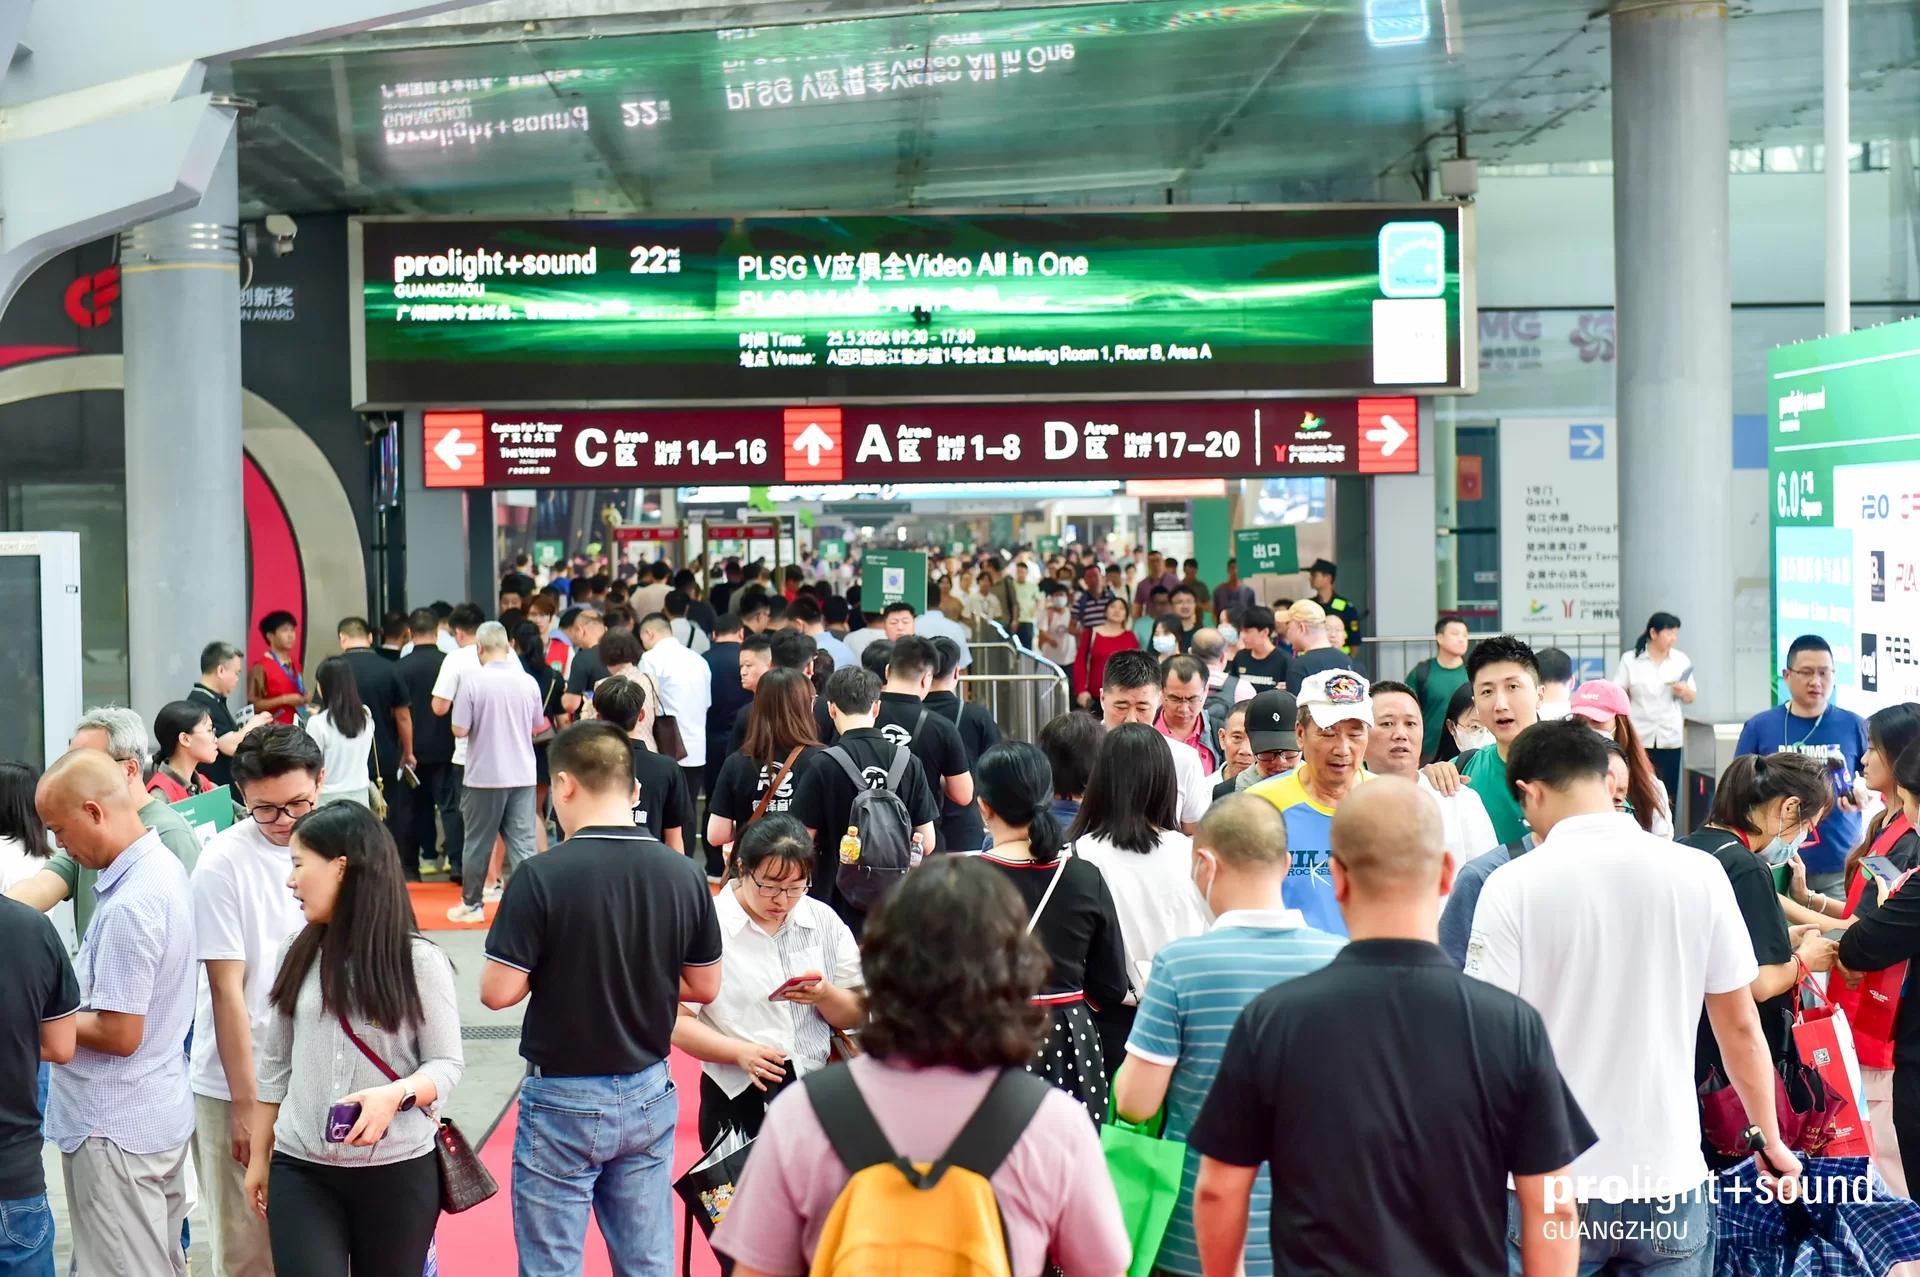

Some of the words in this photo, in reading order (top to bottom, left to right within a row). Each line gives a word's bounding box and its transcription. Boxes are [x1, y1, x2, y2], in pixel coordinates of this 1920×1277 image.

[394, 246, 597, 283] prolight+sound
[738, 255, 808, 281] PLSG
[976, 251, 1007, 277] All
[1012, 251, 1034, 277] in
[1038, 251, 1089, 277] One
[253, 308, 296, 322] AWARD
[574, 427, 608, 468] C
[615, 443, 638, 466] 区
[855, 423, 893, 463] A
[898, 439, 921, 462] 区
[1044, 421, 1079, 460] D
[1085, 435, 1109, 460] 区
